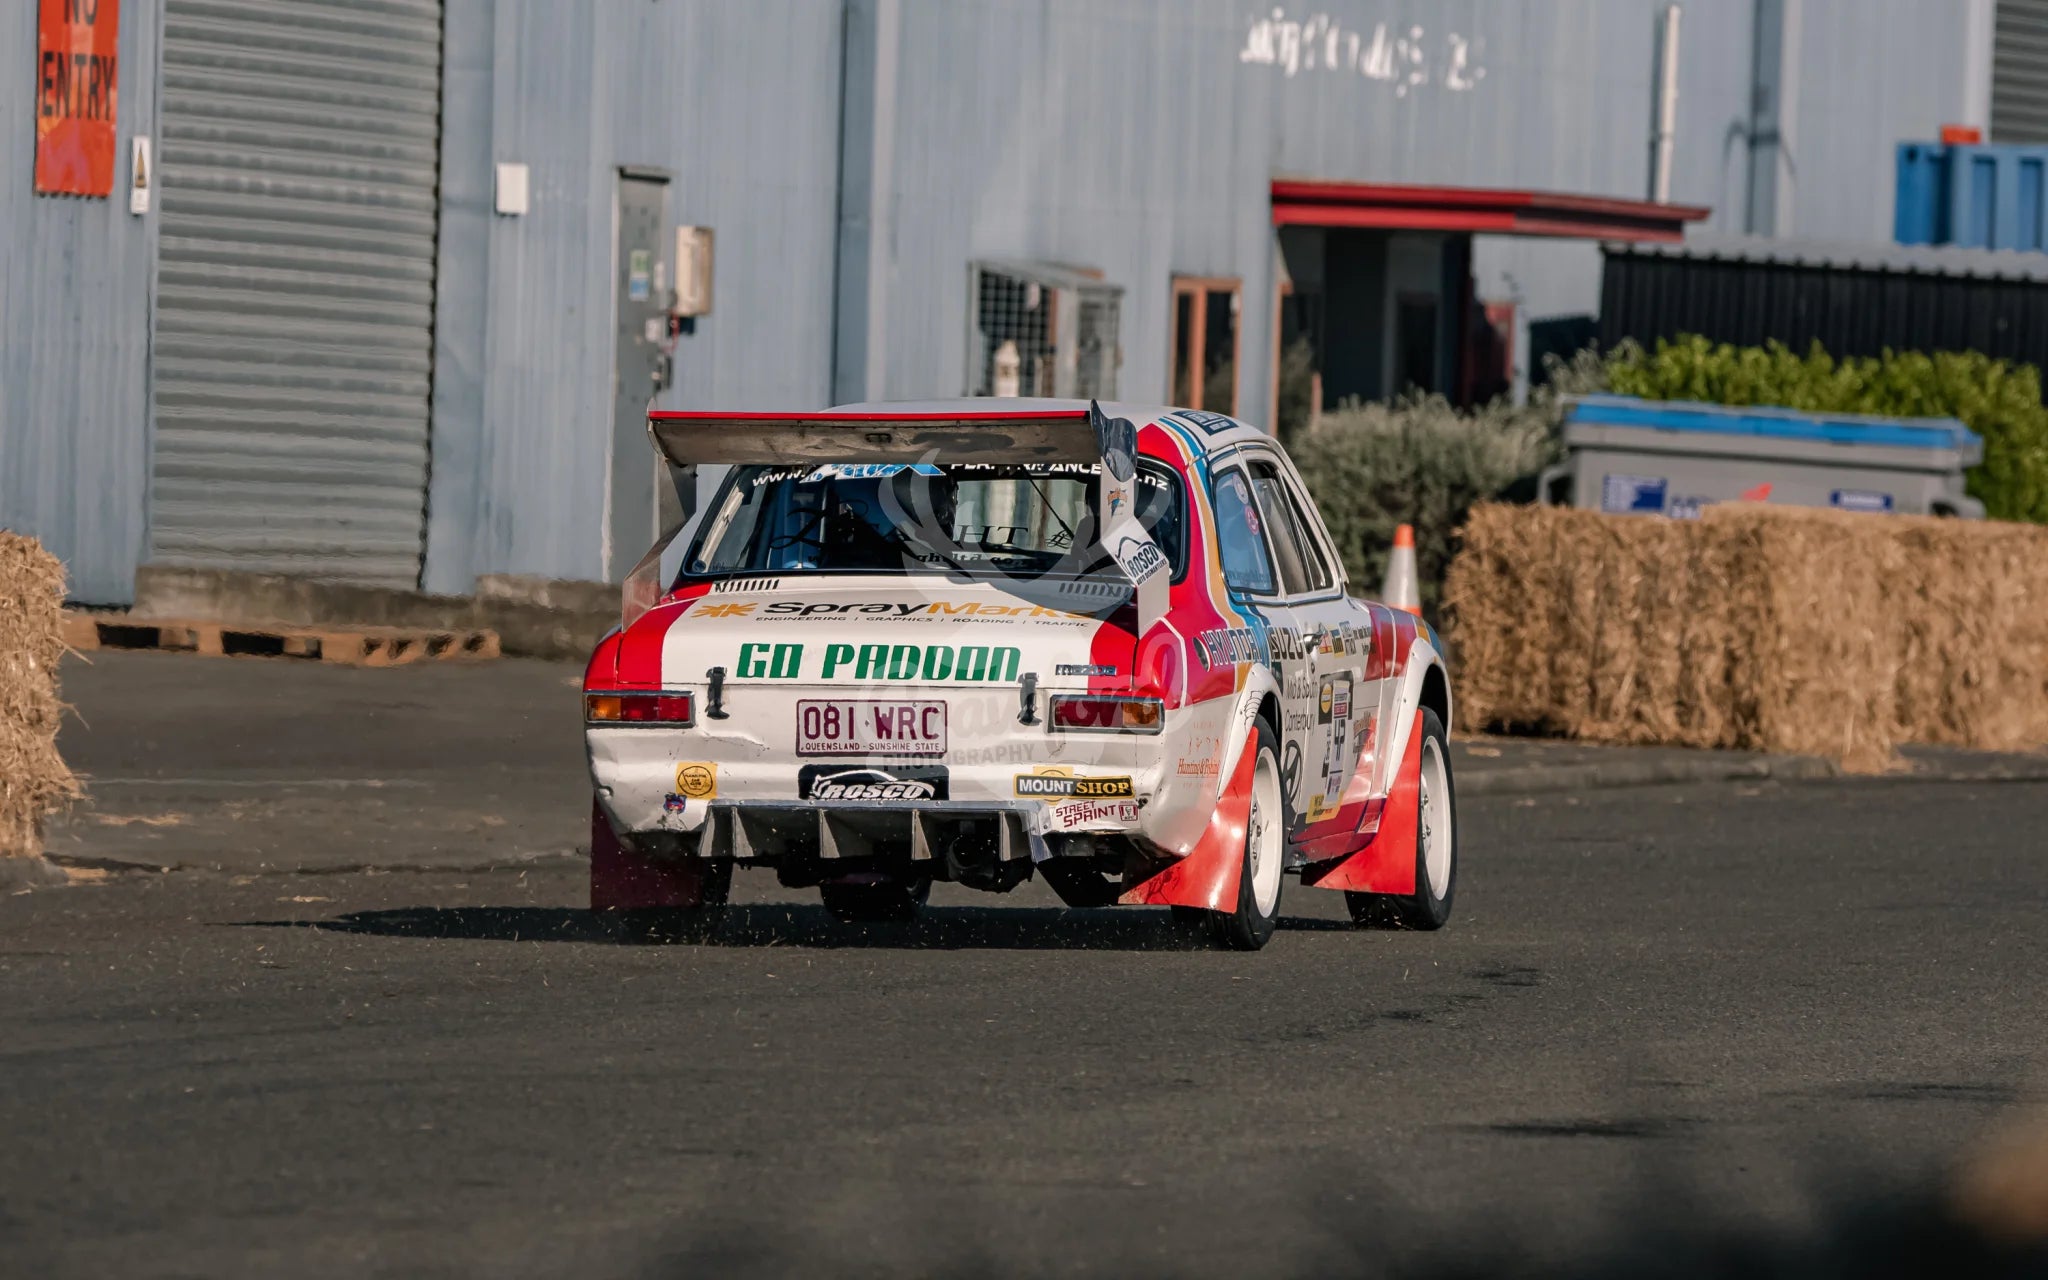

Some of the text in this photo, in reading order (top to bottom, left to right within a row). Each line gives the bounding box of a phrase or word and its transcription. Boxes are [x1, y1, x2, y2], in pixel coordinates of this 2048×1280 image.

[42, 52, 115, 121] ENTRY
[1127, 545, 1160, 578] ROSCO
[1201, 628, 1263, 667] HYUNDAI
[736, 643, 1021, 682] GO PADDON
[804, 706, 940, 740] 081 WRC
[805, 742, 860, 750] QUEENSLAND
[869, 742, 910, 750] SUNSHINE
[915, 742, 940, 750] STATE
[820, 784, 924, 799] ROSCO
[1019, 779, 1130, 794] MOUNT SHOP
[1055, 800, 1096, 818] STREET
[1063, 804, 1117, 828] SPRINT
